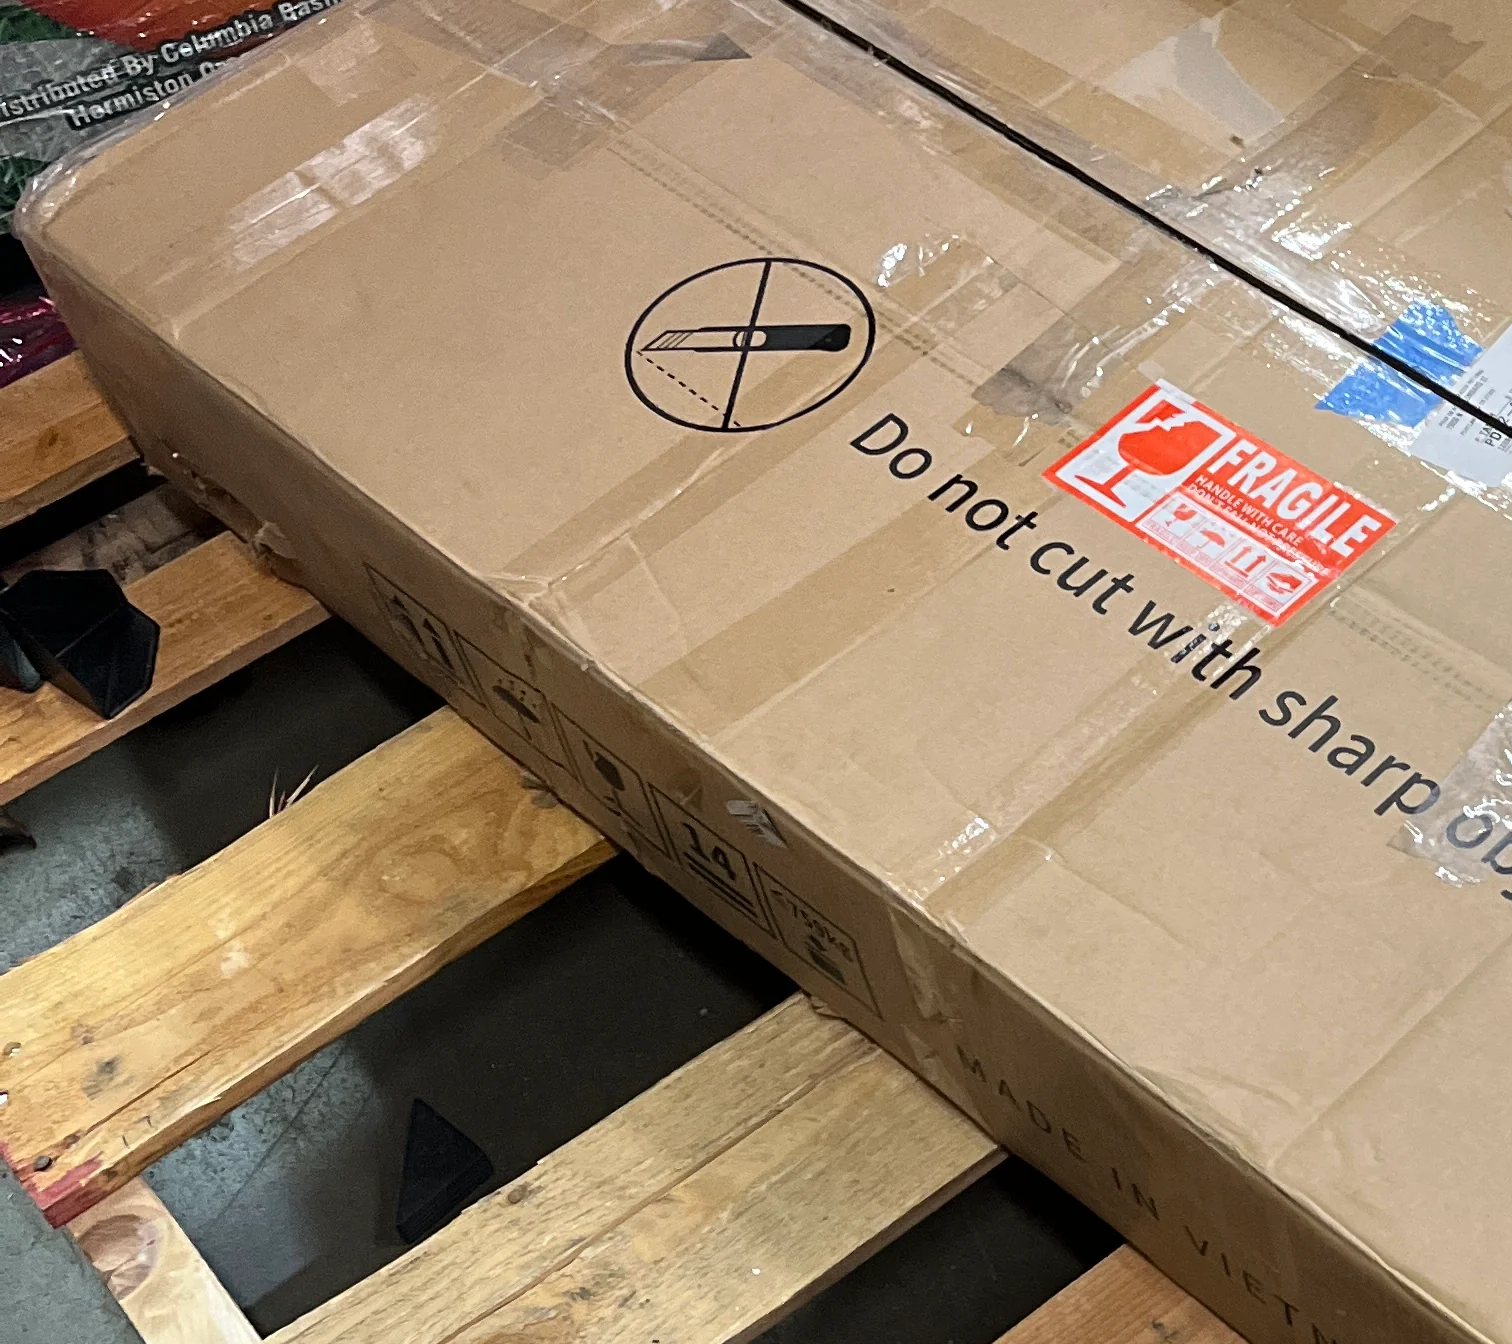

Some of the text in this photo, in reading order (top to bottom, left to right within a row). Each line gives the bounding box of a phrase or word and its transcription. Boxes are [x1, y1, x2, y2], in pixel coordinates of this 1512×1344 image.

[0, 62, 123, 119] istributed
[124, 53, 155, 80] By
[161, 10, 274, 65] Columbia
[67, 71, 200, 128] Hermiston
[1194, 474, 1305, 547] HANDLE WITH CARE
[1206, 438, 1383, 558] FRAGILE
[849, 414, 933, 481] Do
[930, 467, 1042, 552] not
[1030, 539, 1135, 616] cut
[1129, 601, 1263, 701] with
[1259, 686, 1442, 818] sharp
[956, 1045, 1087, 1161] MADE
[1111, 1166, 1160, 1222] IN
